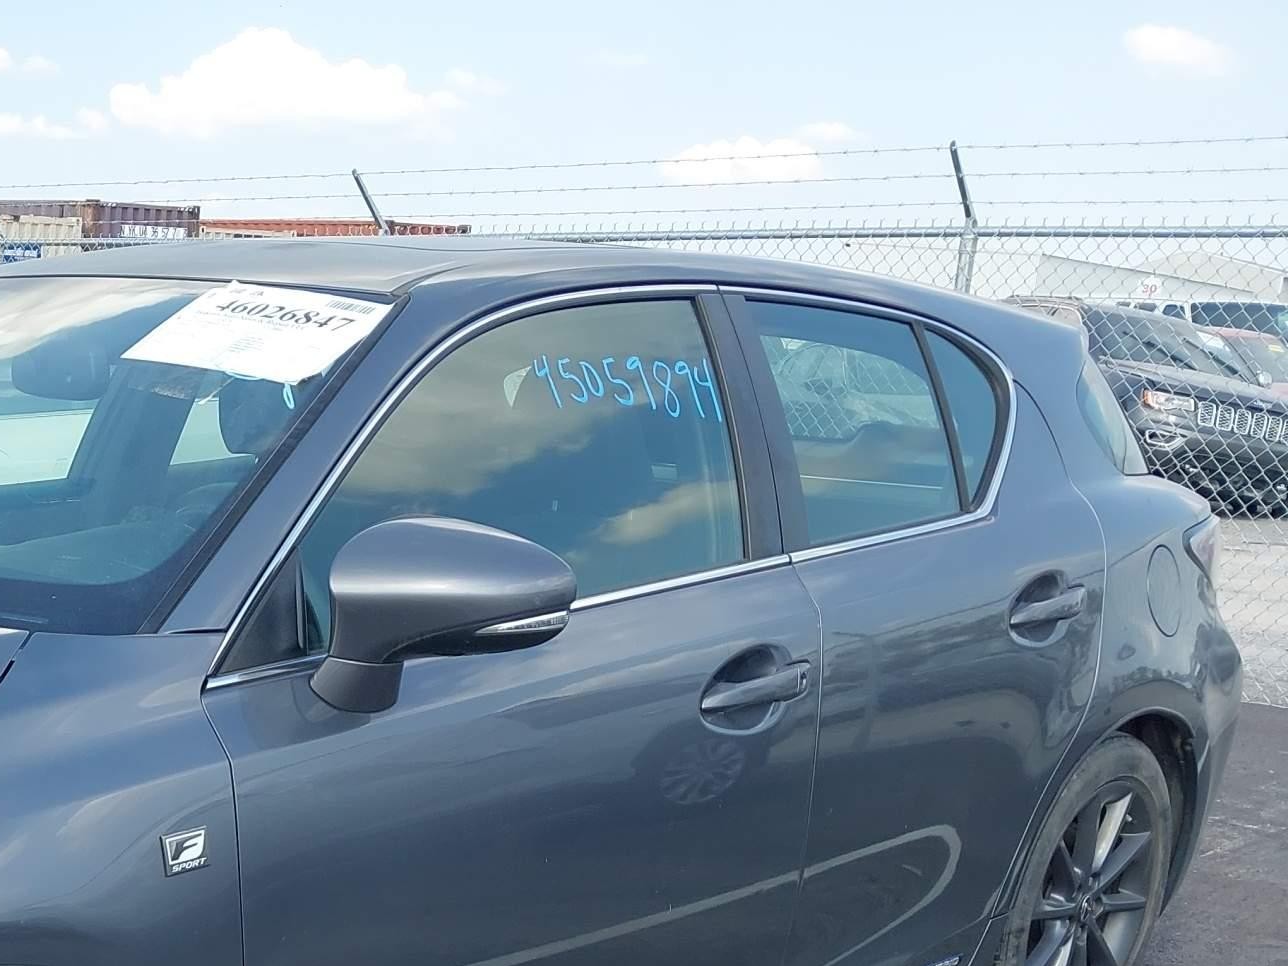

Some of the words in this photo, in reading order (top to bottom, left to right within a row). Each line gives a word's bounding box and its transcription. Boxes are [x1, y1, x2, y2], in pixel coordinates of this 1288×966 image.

[216, 299, 356, 331] 46026847
[534, 355, 722, 423] 45059894
[171, 857, 208, 873] SPORT
